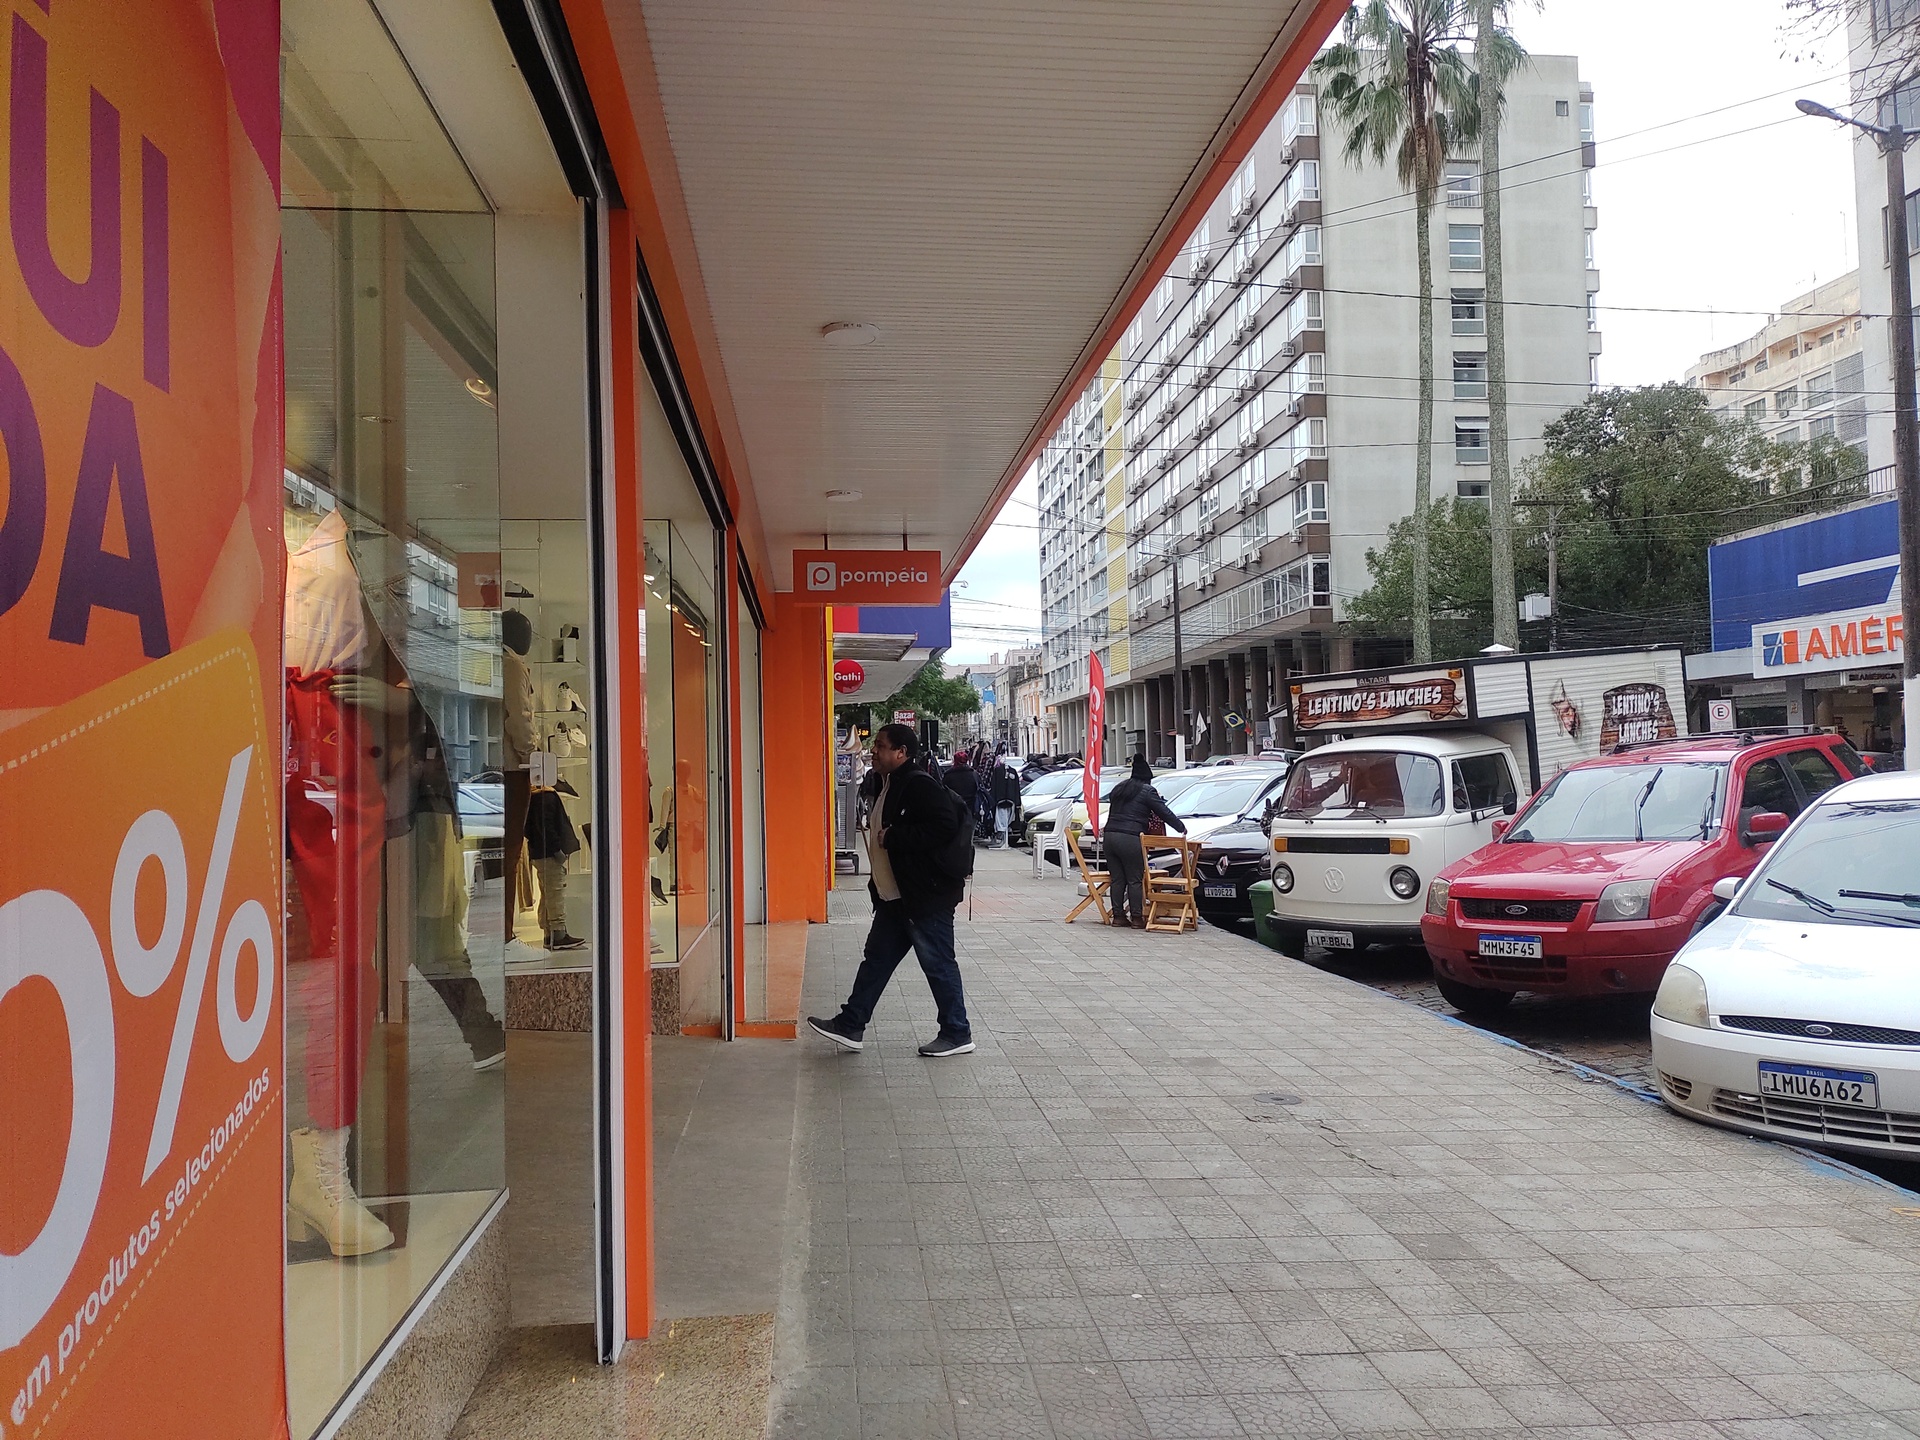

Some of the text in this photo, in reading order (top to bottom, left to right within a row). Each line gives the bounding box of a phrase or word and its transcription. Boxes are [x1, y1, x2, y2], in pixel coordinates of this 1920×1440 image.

[840, 567, 928, 587] pompéia
[834, 672, 861, 681] Gathi
[1308, 686, 1442, 716] LENTINO'S LANCHES
[1612, 690, 1660, 716] LENTINO'S
[894, 711, 916, 720] Bazar
[1619, 720, 1659, 743] LANCHES
[1484, 941, 1535, 956] MMW3F45
[1806, 1069, 1825, 1077] BRASIL
[1770, 1073, 1863, 1103] IMU6A62
[10, 1067, 270, 1426] em produtos selecionados
